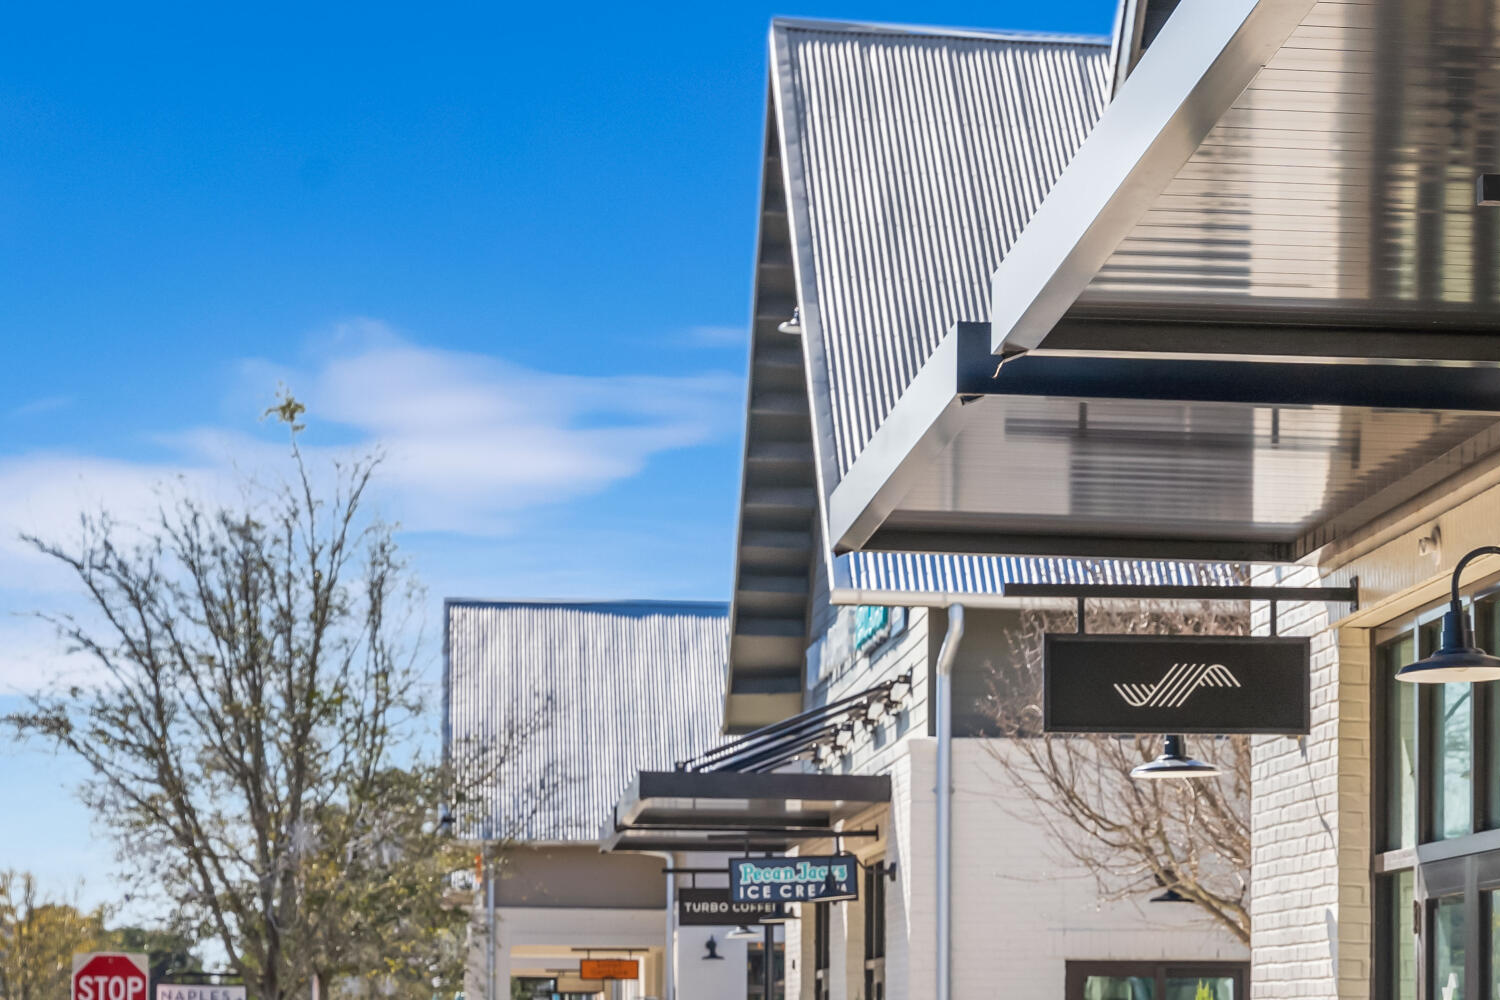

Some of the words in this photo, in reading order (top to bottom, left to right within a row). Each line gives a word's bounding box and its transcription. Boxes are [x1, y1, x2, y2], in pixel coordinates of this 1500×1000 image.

[739, 863, 796, 885] Pecan
[739, 885, 771, 899] ICE
[684, 902, 729, 913] TURBO
